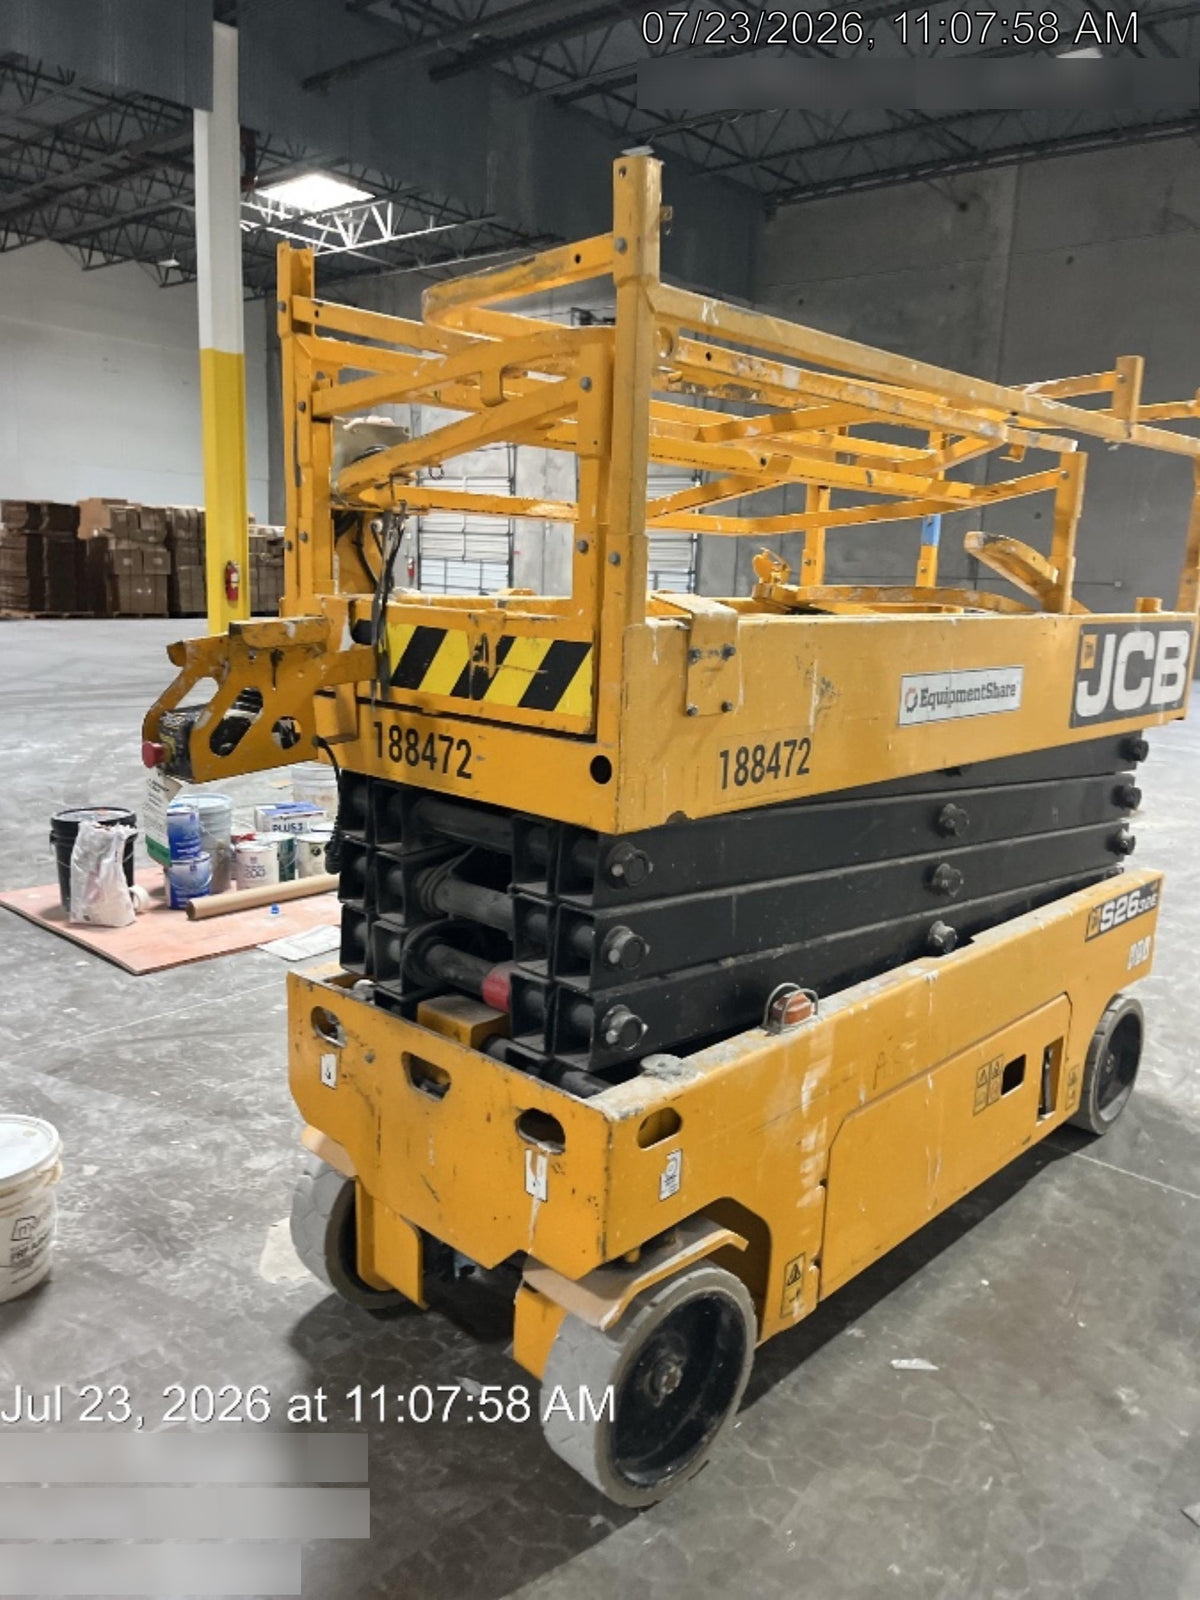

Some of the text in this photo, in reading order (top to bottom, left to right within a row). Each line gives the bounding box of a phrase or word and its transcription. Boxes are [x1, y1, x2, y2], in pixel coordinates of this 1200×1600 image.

[919, 682, 1017, 710] EquipmentShare
[1076, 629, 1190, 717] JCB
[373, 721, 472, 779] 188472
[720, 737, 811, 790] 188472
